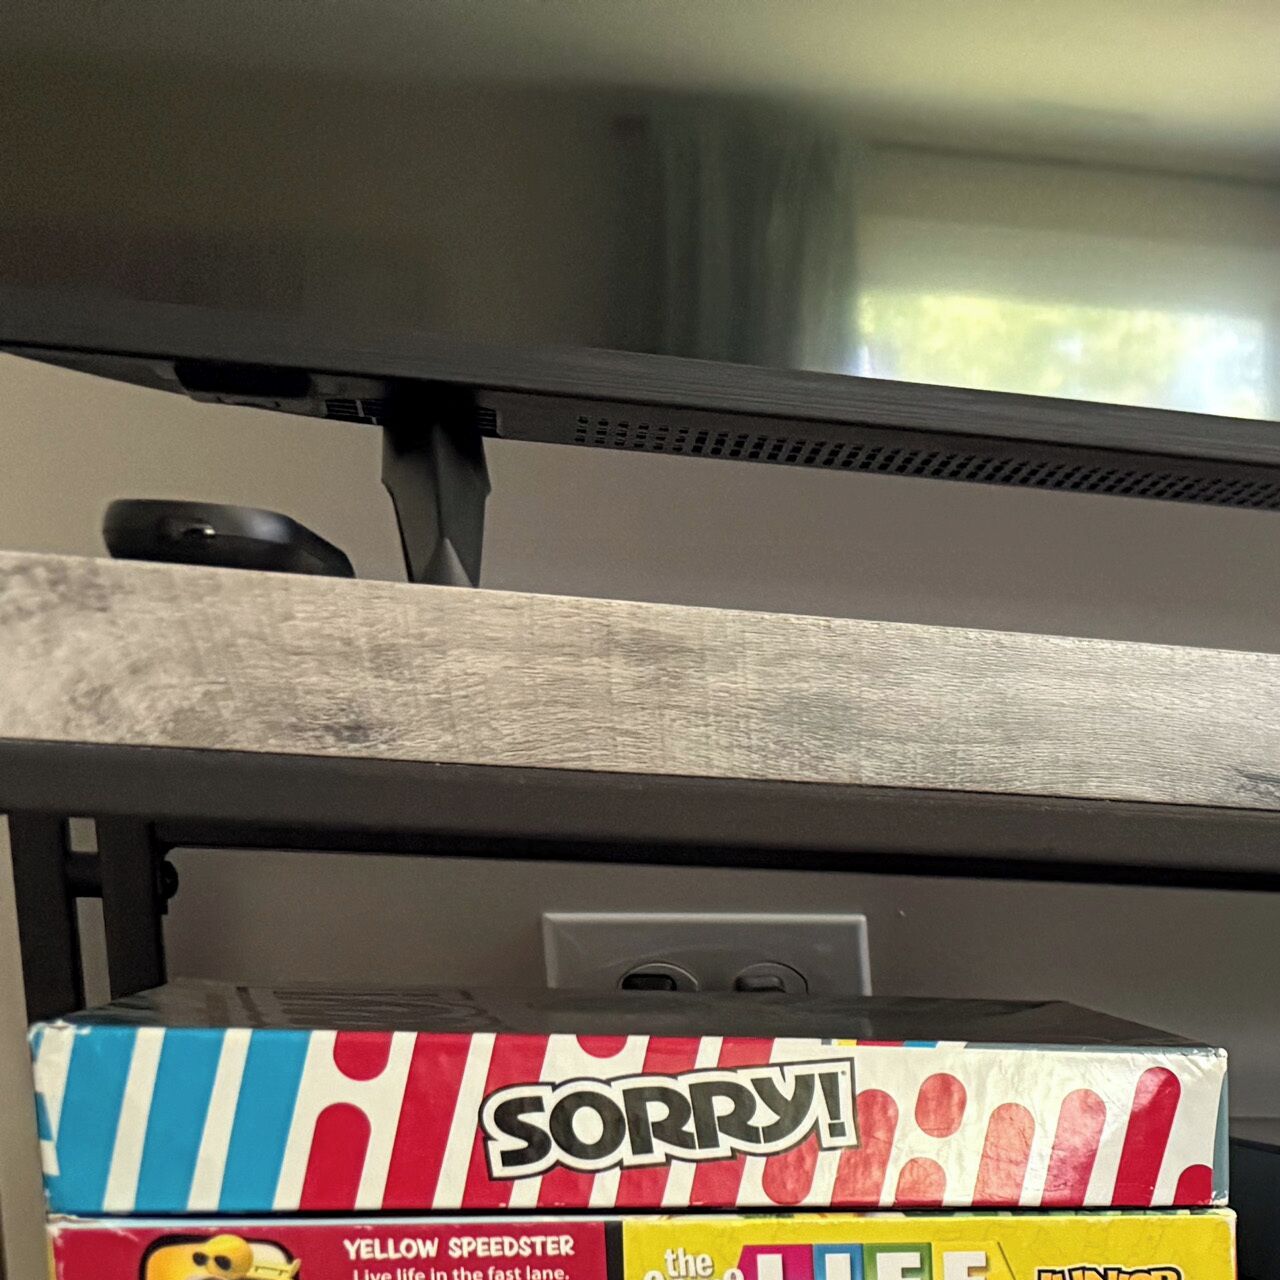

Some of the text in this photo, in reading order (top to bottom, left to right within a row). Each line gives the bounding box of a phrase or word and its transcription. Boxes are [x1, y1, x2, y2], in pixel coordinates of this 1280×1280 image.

[490, 1068, 845, 1170] SORRY!
[343, 1235, 575, 1260] YELLOW SPEEDSTER
[526, 1265, 569, 1280] lane.
[663, 1246, 713, 1278] the
